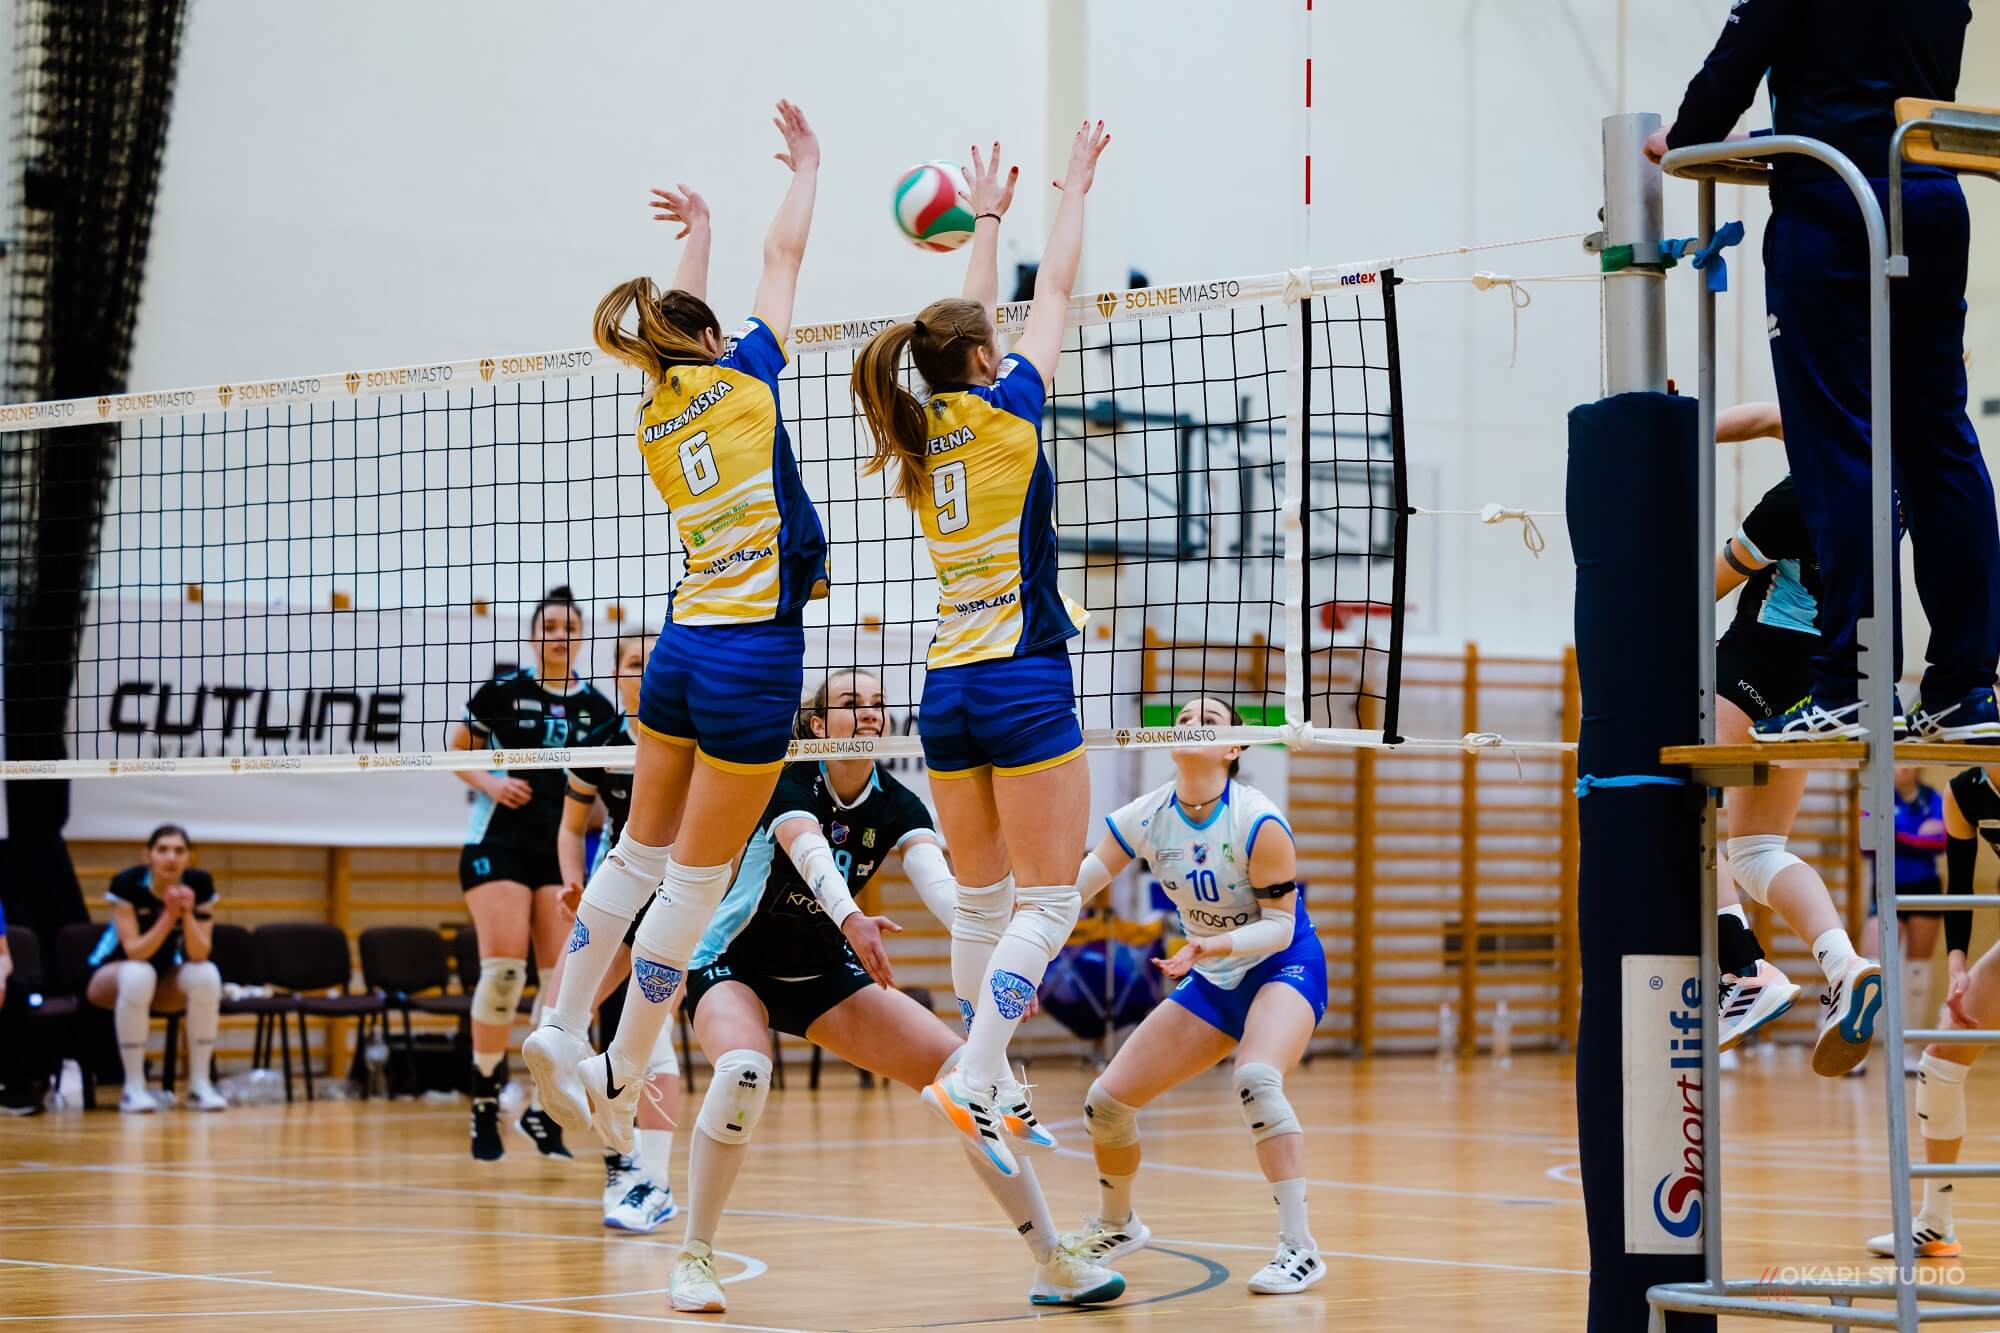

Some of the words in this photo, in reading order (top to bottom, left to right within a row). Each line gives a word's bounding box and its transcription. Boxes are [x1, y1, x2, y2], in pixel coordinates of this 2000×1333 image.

[1341, 272, 1376, 286] netex
[1125, 281, 1240, 309] SOLNEMIASTO
[502, 351, 593, 375] SOLNEMIASTO
[367, 365, 453, 388] SOLNEMIASTO
[239, 378, 320, 401] SOLNEMIASTO
[0, 403, 75, 423] SOLNEMIASTO
[116, 391, 195, 412] SOLNEMIASTO
[642, 379, 734, 446] MUSZYŃSKA
[924, 425, 977, 457] EŁNA
[678, 431, 720, 497] 6
[930, 460, 970, 536] 9
[803, 740, 874, 754] SOLNEMIASTO
[1135, 729, 1217, 744] SOLNEMIASTO
[122, 761, 176, 772] SOLNEMIASTO
[244, 759, 301, 770] SOLNEMIASTO
[372, 755, 432, 767] SOLNEMIASTO
[508, 751, 571, 764] SOLNEMIASTO
[831, 849, 852, 885] 8
[1186, 869, 1220, 902] 10
